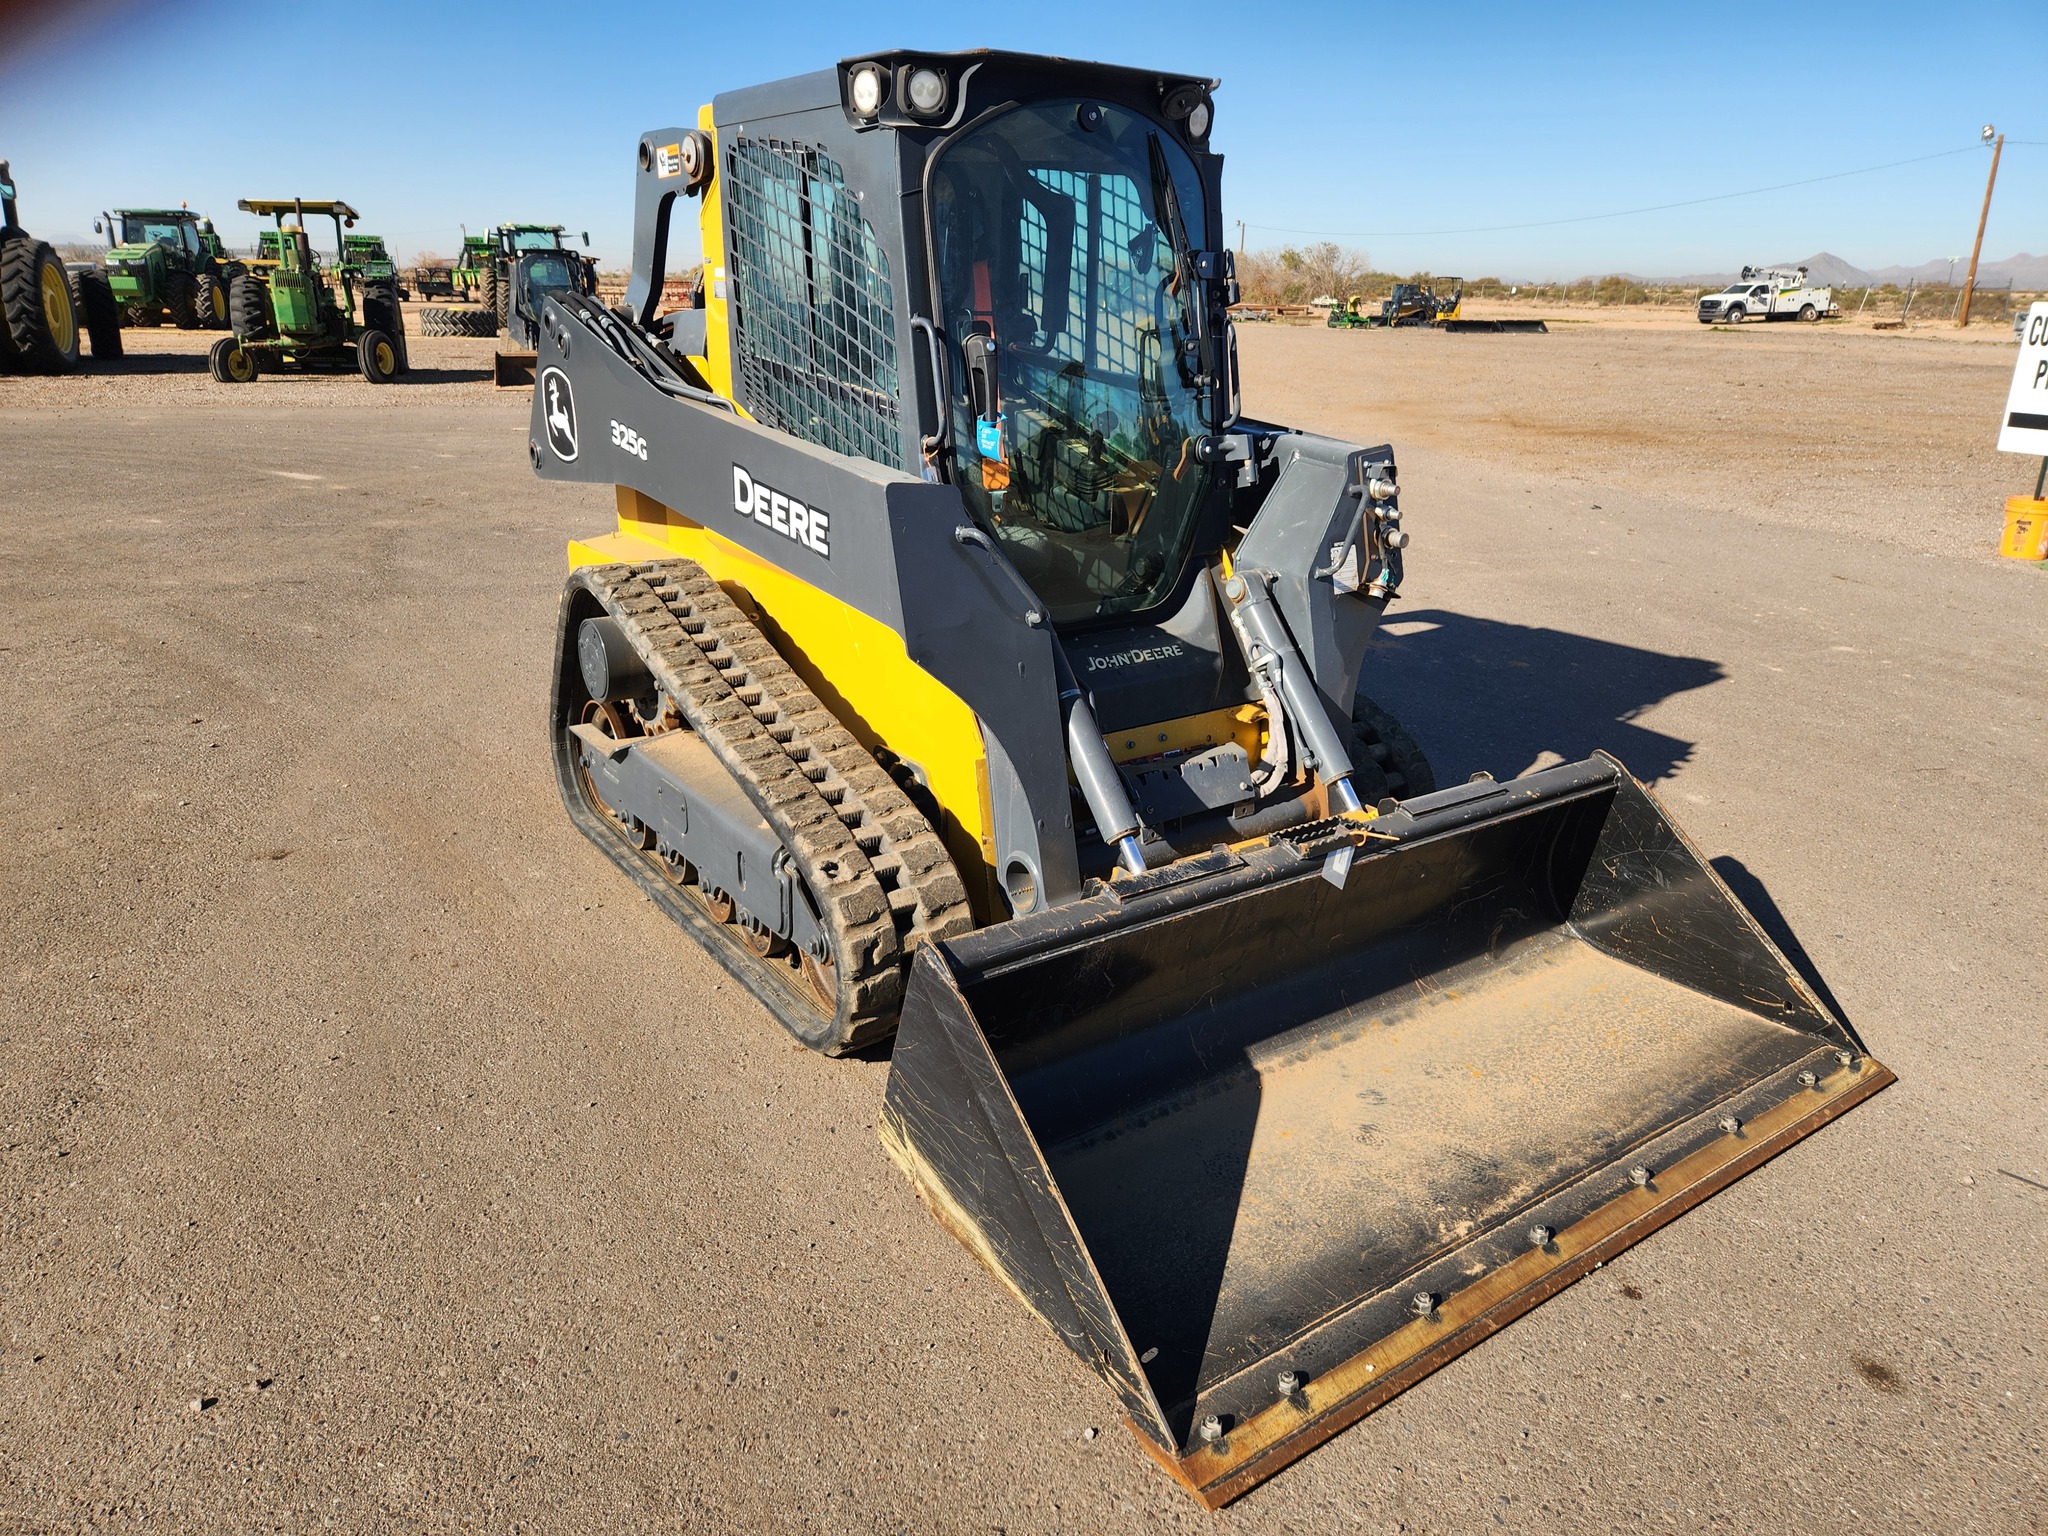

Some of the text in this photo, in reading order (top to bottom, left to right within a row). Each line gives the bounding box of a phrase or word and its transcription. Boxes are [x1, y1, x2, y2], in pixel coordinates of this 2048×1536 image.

[2033, 360, 2048, 389] P
[610, 418, 648, 462] 325G
[733, 465, 830, 556] DEERE
[1088, 644, 1184, 671] JOHN DEERE
